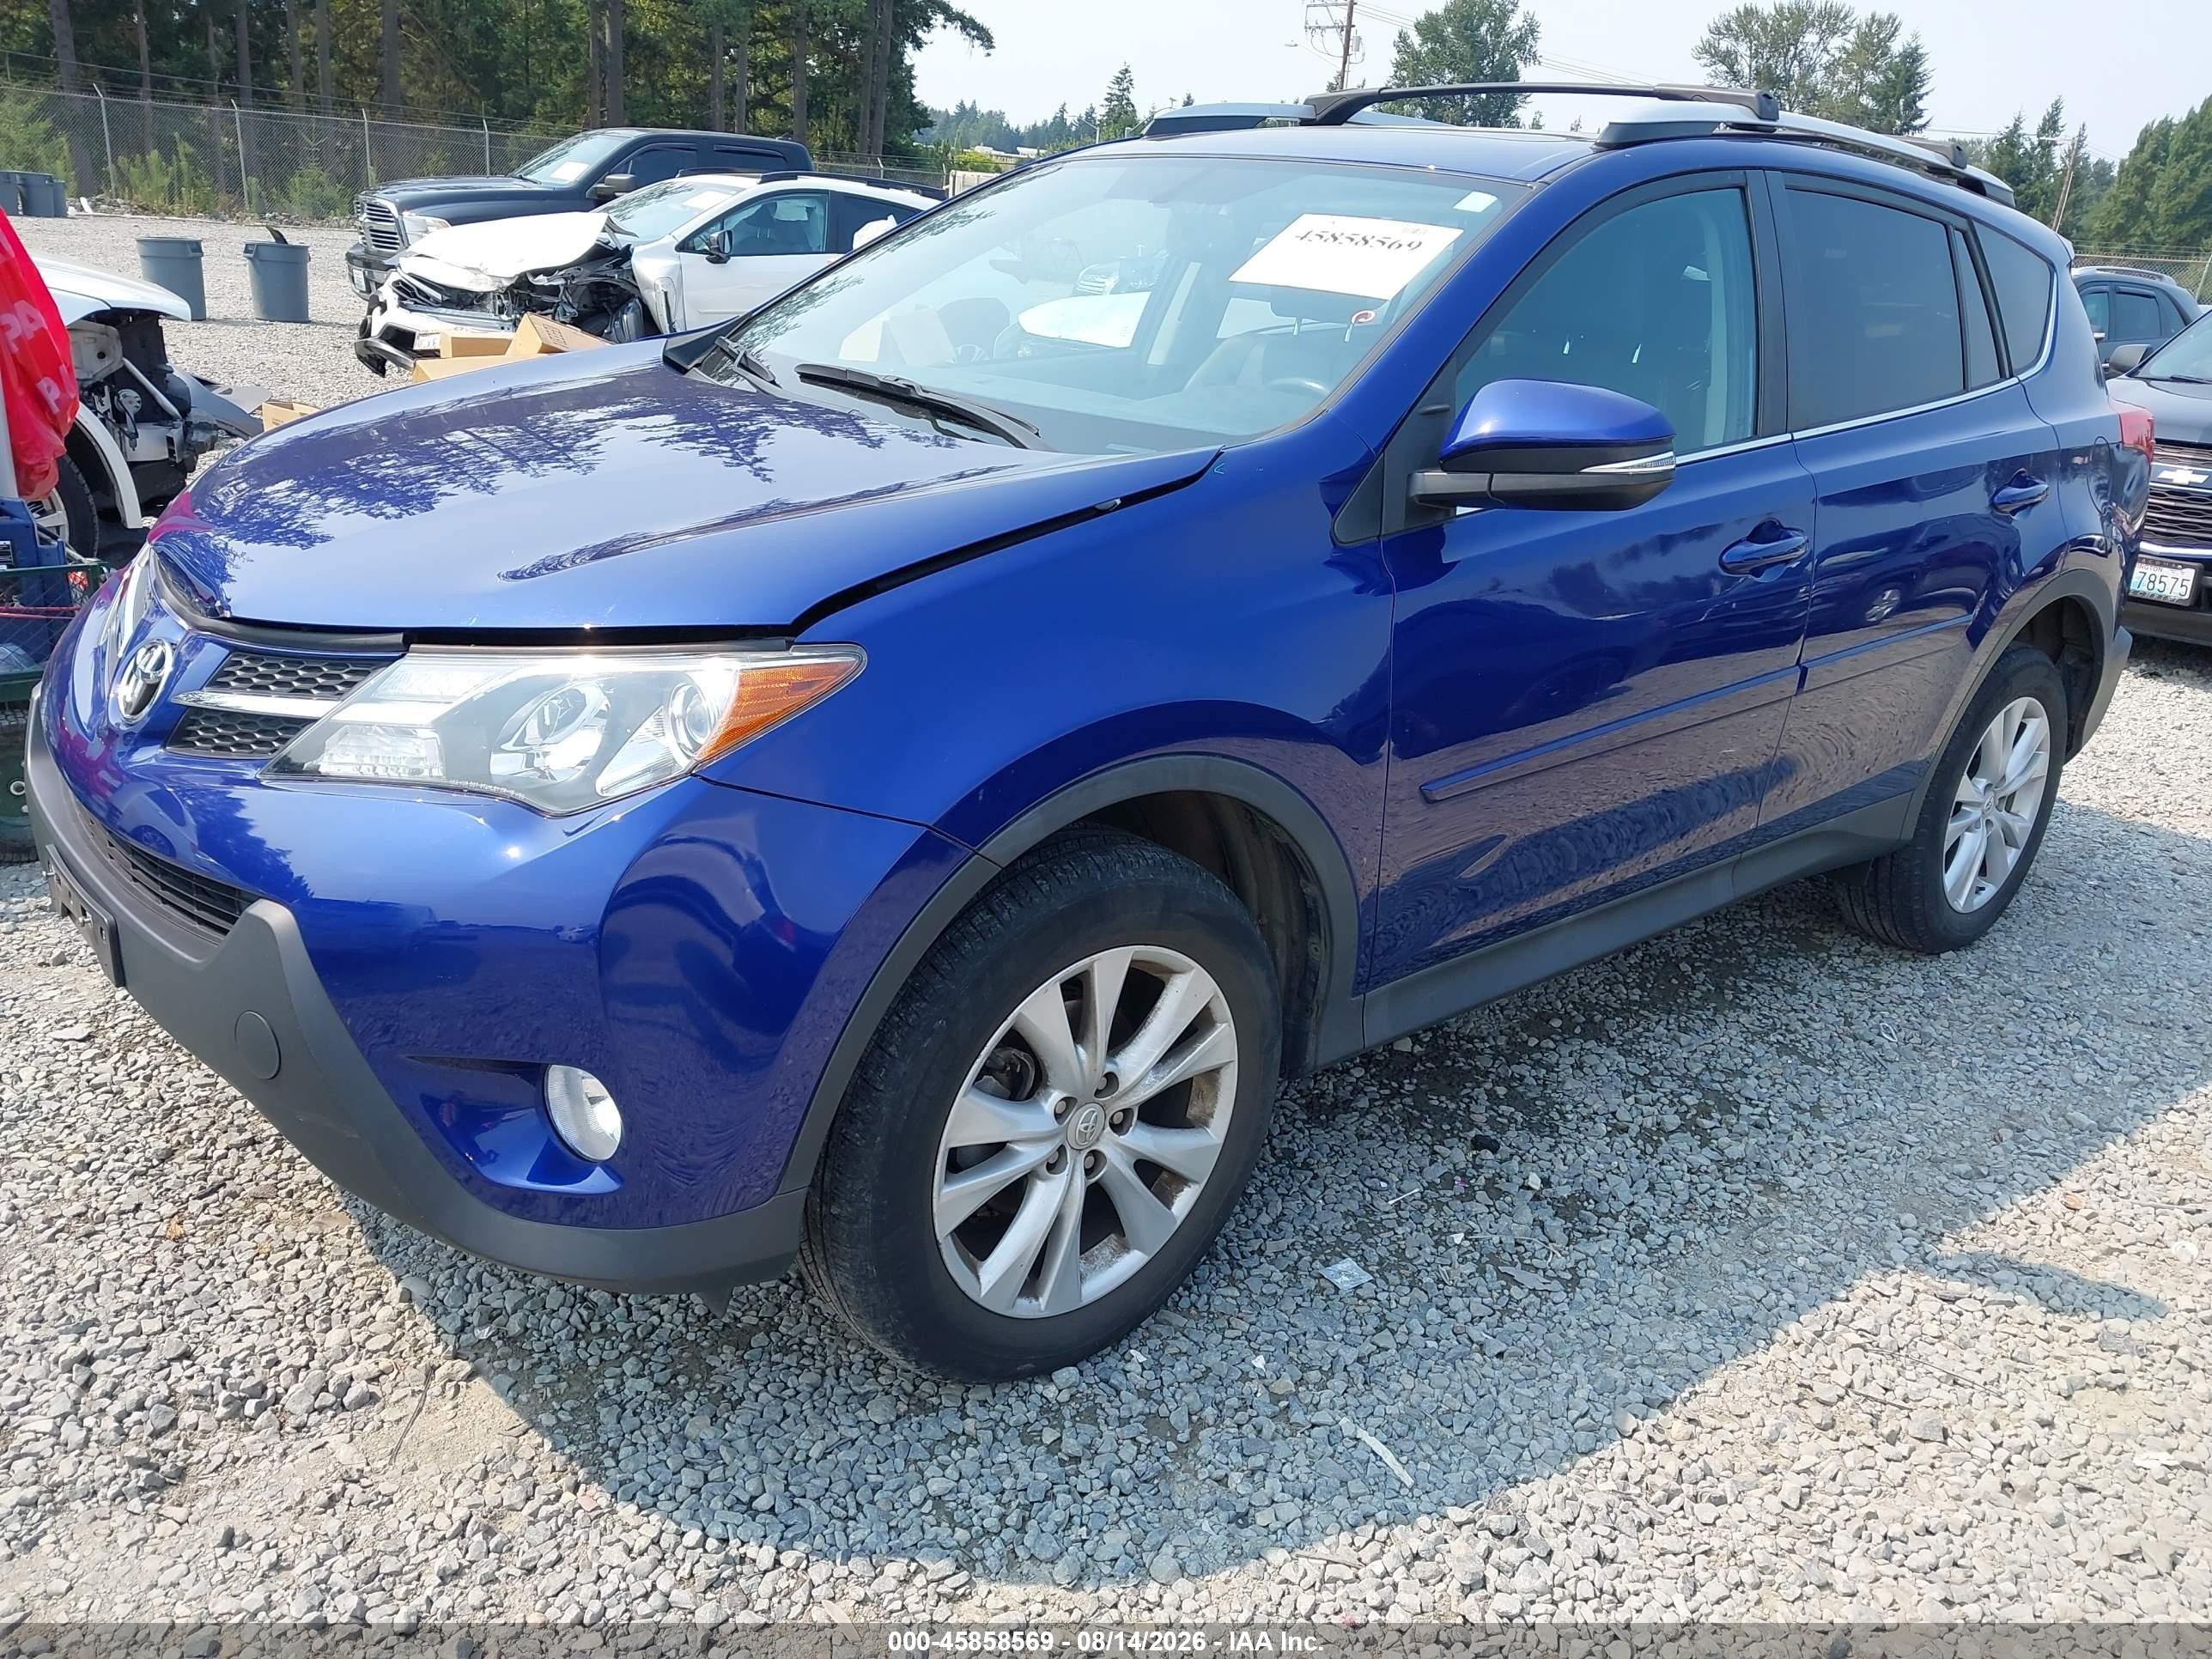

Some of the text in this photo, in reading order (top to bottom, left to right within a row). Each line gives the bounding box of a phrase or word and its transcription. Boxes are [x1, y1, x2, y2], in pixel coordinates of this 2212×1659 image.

[2137, 563, 2163, 573] INGTON
[2139, 558, 2176, 568] ACOMA
[2136, 570, 2191, 597] 78575
